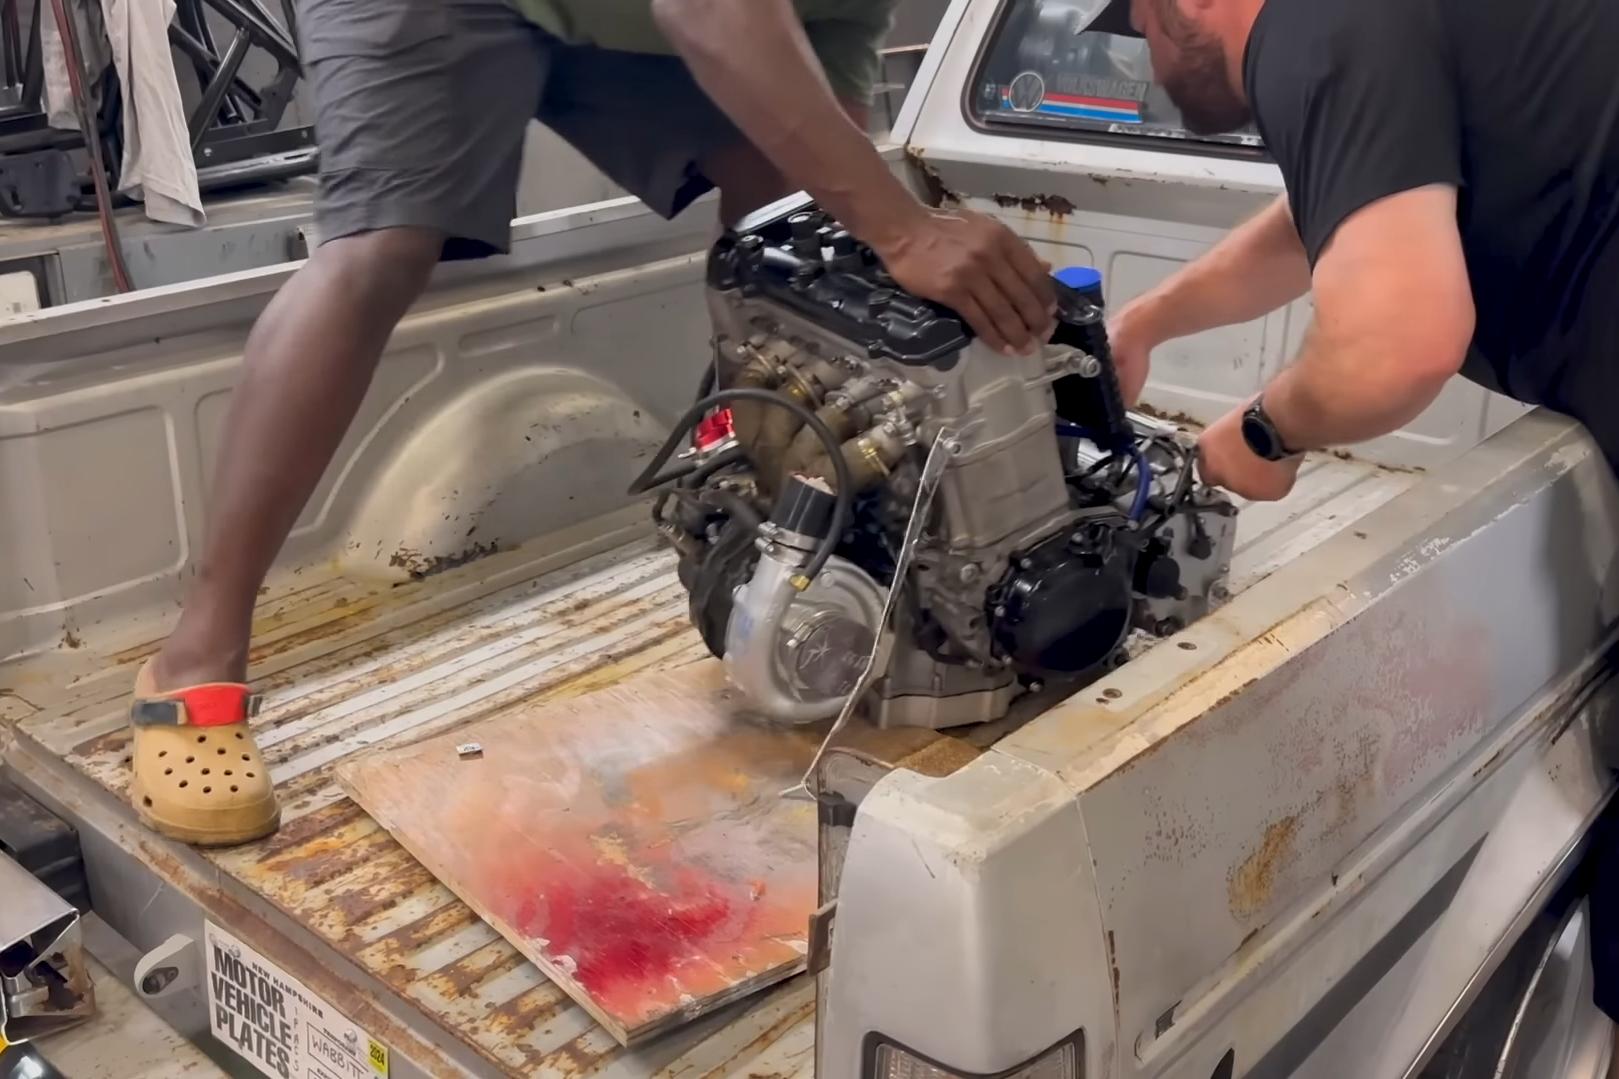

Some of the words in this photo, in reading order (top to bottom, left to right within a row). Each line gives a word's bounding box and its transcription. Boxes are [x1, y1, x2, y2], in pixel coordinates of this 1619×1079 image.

[211, 971, 292, 1051] VEHICLE
[213, 945, 287, 1019] MOTOR
[252, 962, 270, 980] NEW
[273, 976, 323, 1019] HAMPSHIRE
[215, 1002, 290, 1079] PLATES
[370, 1044, 385, 1066] 2024
